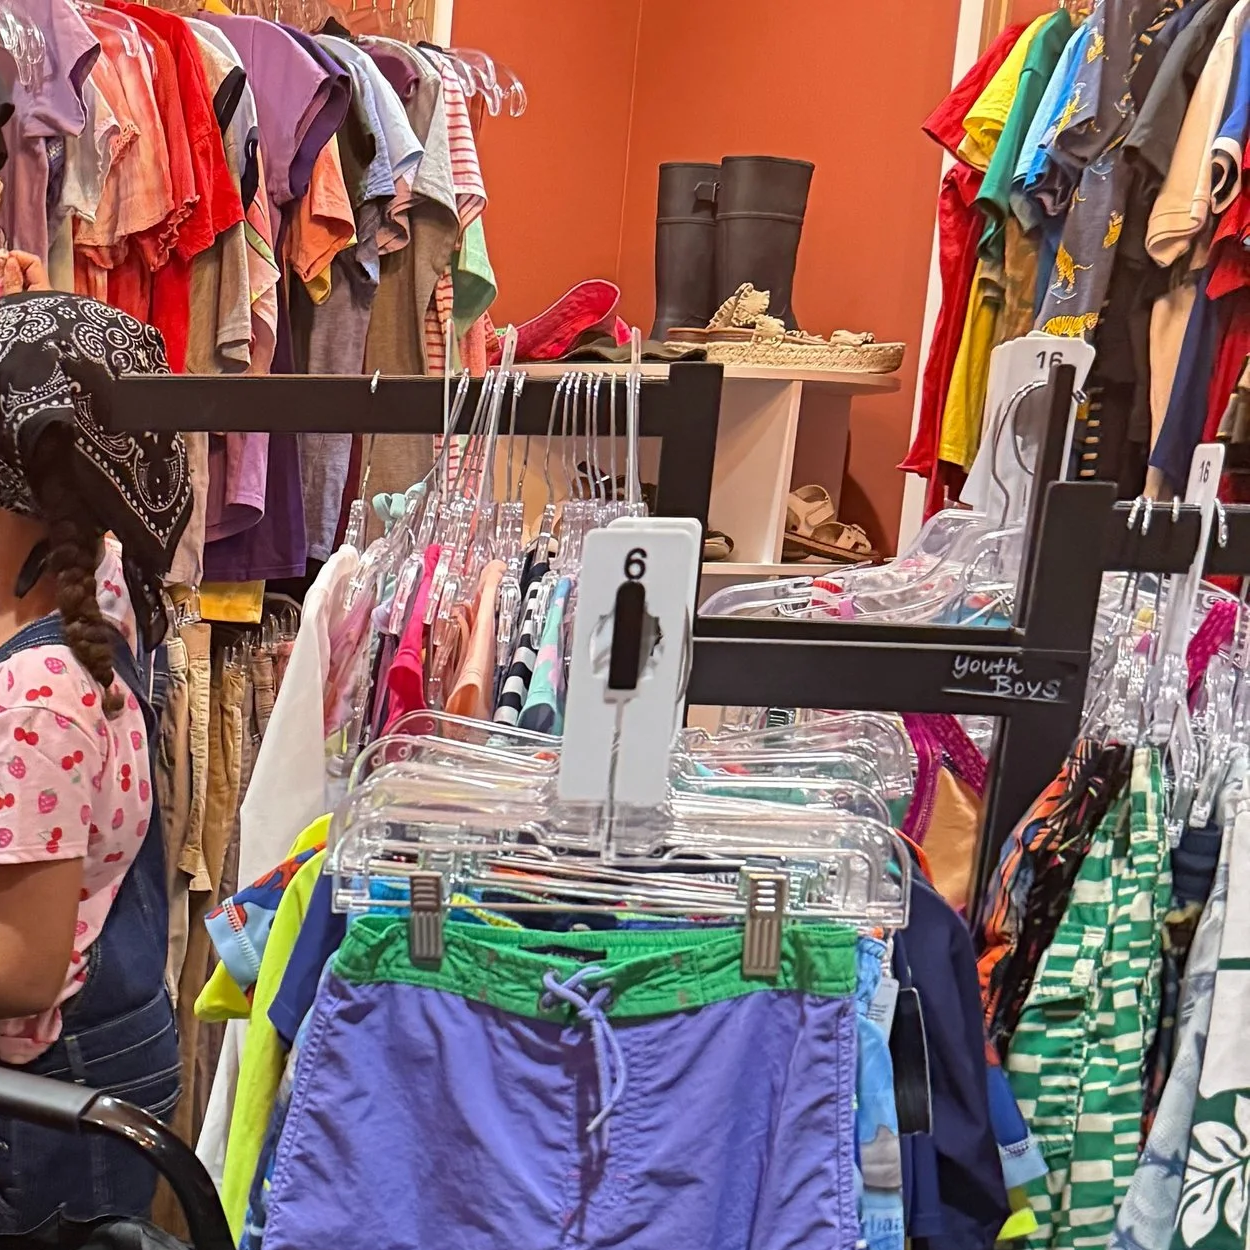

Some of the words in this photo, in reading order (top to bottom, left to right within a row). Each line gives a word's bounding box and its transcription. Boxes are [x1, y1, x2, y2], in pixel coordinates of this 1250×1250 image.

[1036, 351, 1063, 369] 16
[1199, 460, 1211, 483] 16
[624, 547, 647, 580] 6
[989, 675, 1061, 699] Boys
